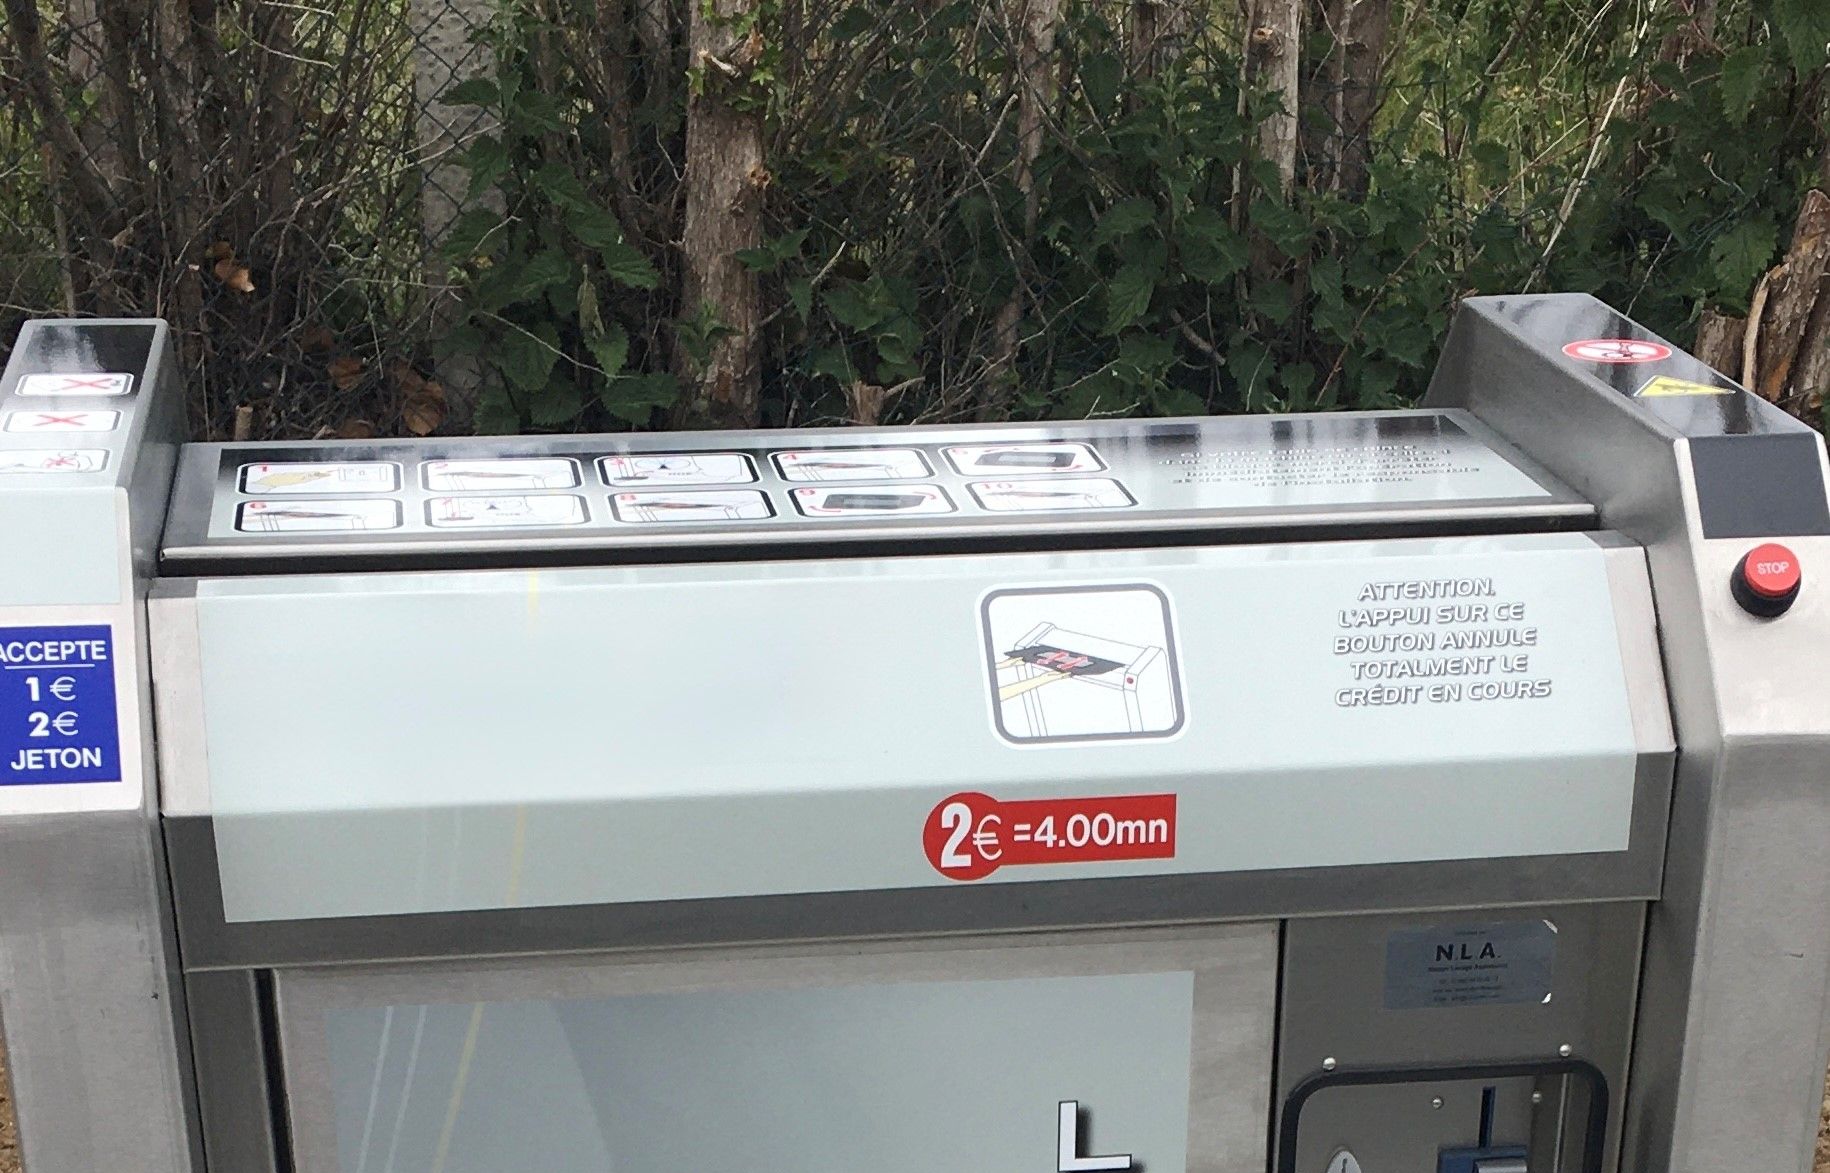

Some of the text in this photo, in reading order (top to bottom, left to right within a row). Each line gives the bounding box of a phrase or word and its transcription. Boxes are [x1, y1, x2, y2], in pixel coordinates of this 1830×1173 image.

[1757, 562, 1789, 575] STOP
[1338, 602, 1525, 628] L'APPUI SUR CE
[1333, 627, 1538, 655] BOUTON ANNULE
[1350, 654, 1528, 681] TOTALMENT LE
[1335, 679, 1553, 708] CRÉDIT EN COURS
[10, 747, 102, 770] JETON
